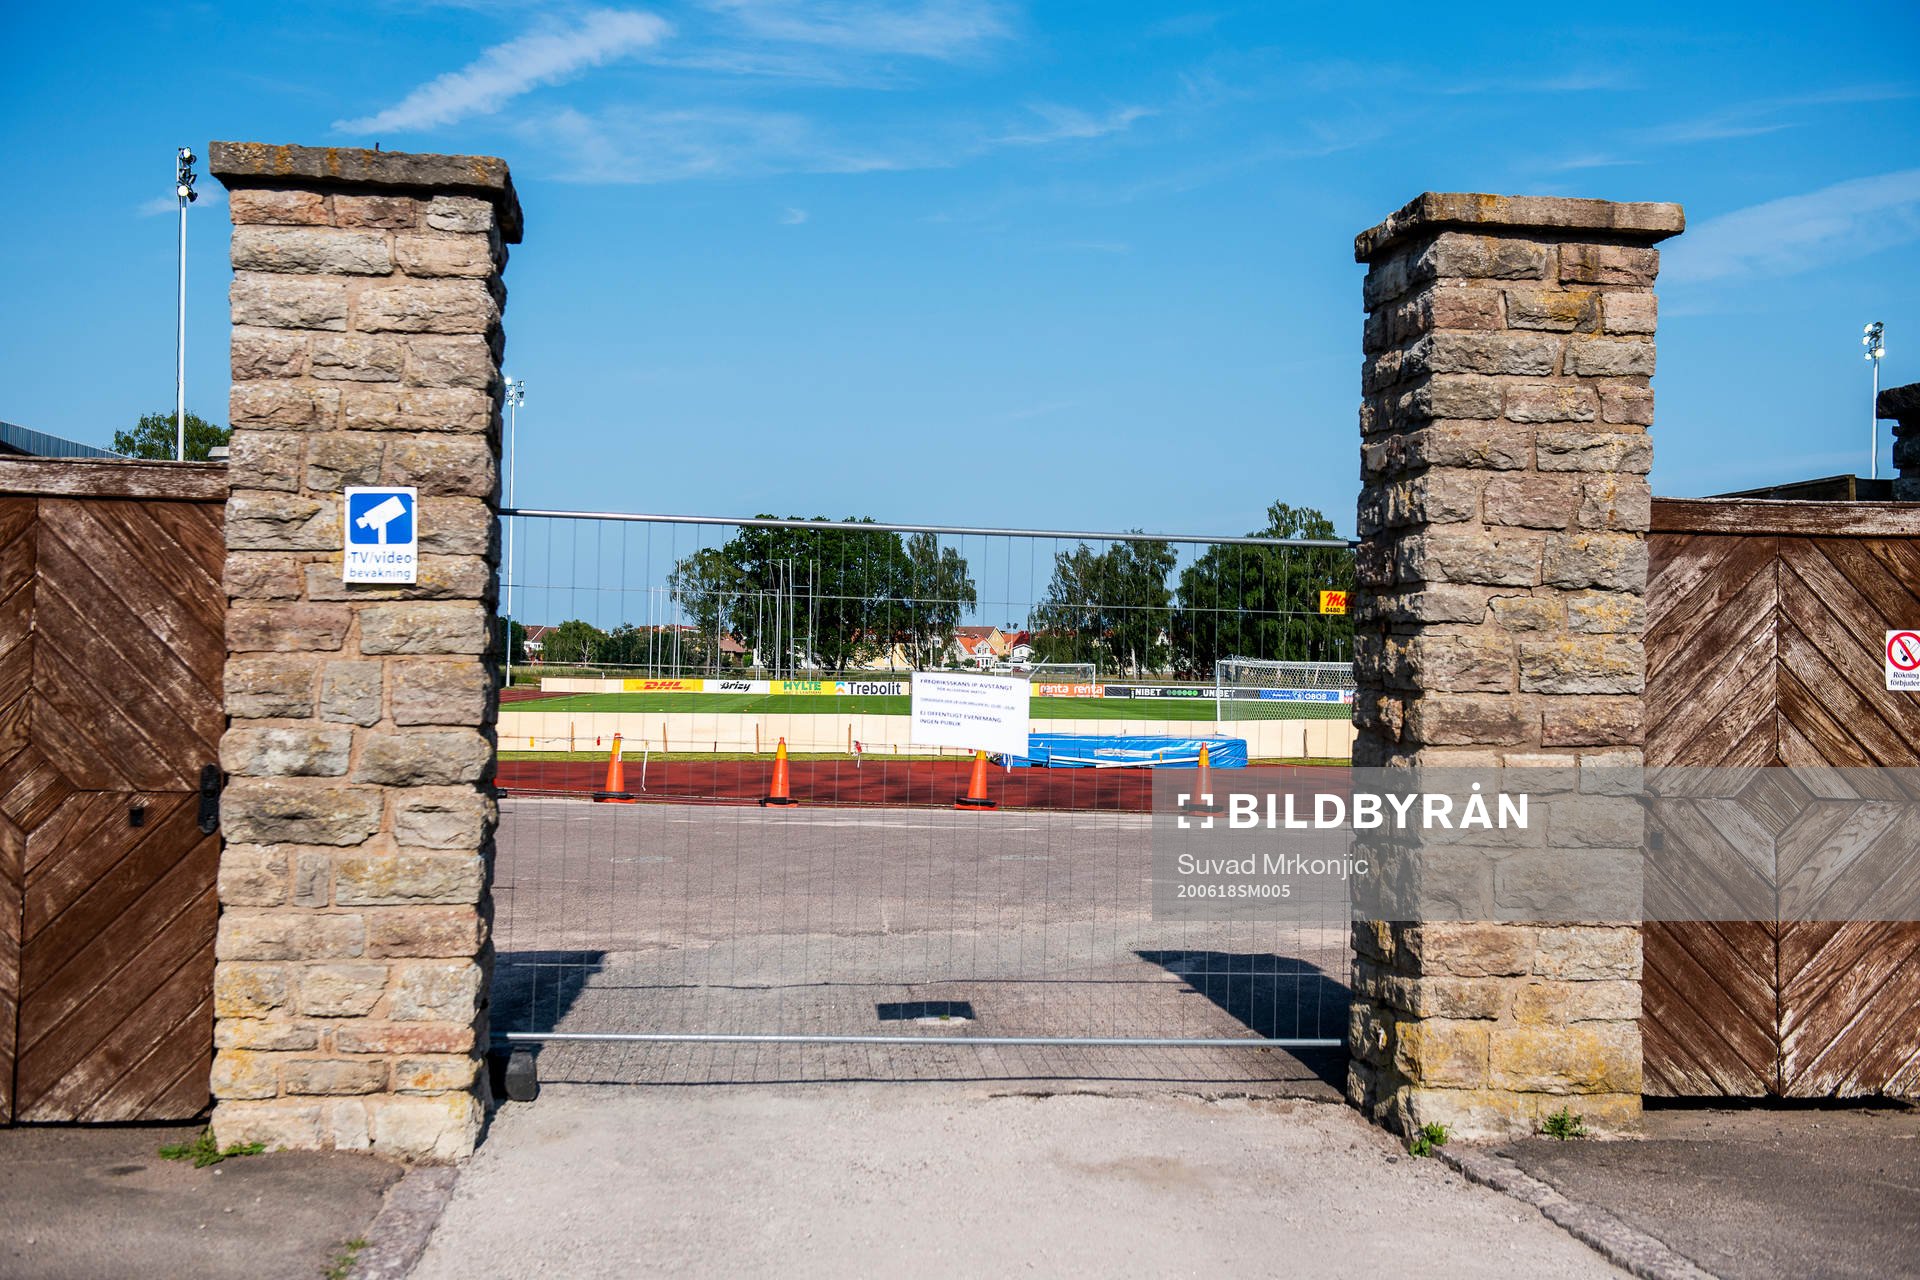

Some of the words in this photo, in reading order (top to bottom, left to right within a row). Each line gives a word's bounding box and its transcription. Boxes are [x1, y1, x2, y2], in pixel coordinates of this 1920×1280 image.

[351, 551, 412, 564] TV/video
[349, 568, 411, 580] bevakning
[1893, 672, 1920, 680] Rökning
[643, 681, 684, 690] DHL
[783, 681, 822, 691] HYLTE
[848, 682, 901, 695] Trebolit
[1040, 685, 1069, 693] renta
[1074, 685, 1103, 694] renta
[963, 714, 1002, 723] EVENEMANG
